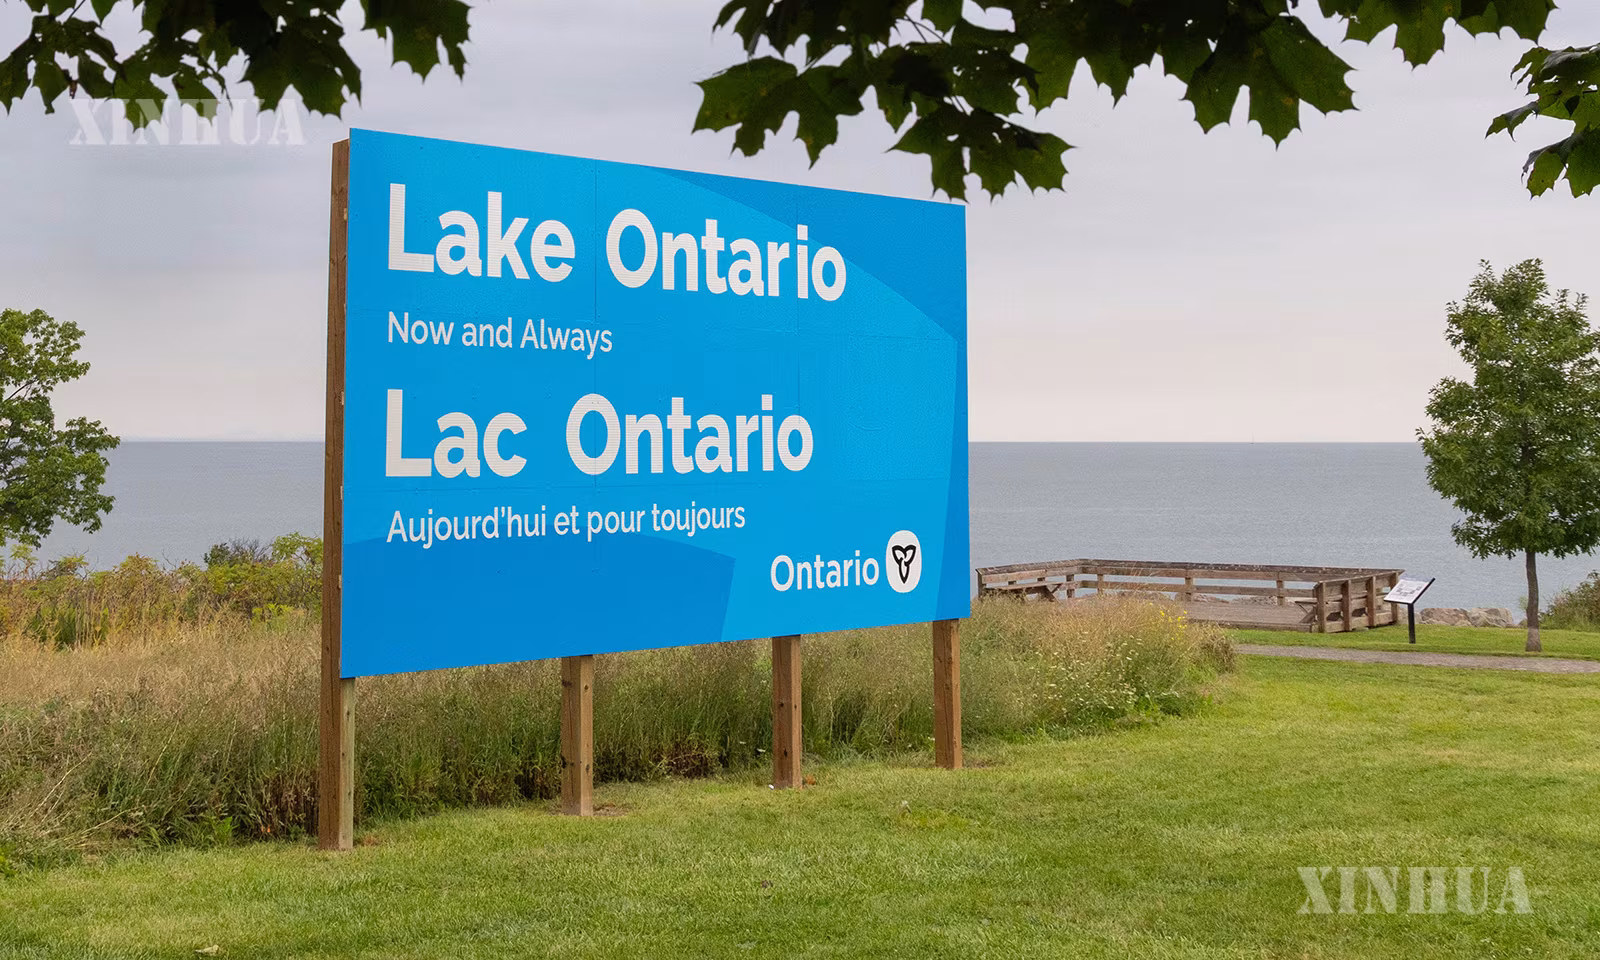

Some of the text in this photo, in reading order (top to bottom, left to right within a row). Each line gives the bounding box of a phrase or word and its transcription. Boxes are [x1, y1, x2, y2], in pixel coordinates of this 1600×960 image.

[388, 184, 847, 302] Lake Ontario
[388, 311, 613, 361] Now and Always
[386, 389, 814, 478] Lac Ontario
[386, 501, 746, 550] Aujourd'hui et pour toujours
[770, 550, 880, 592] Ontario
